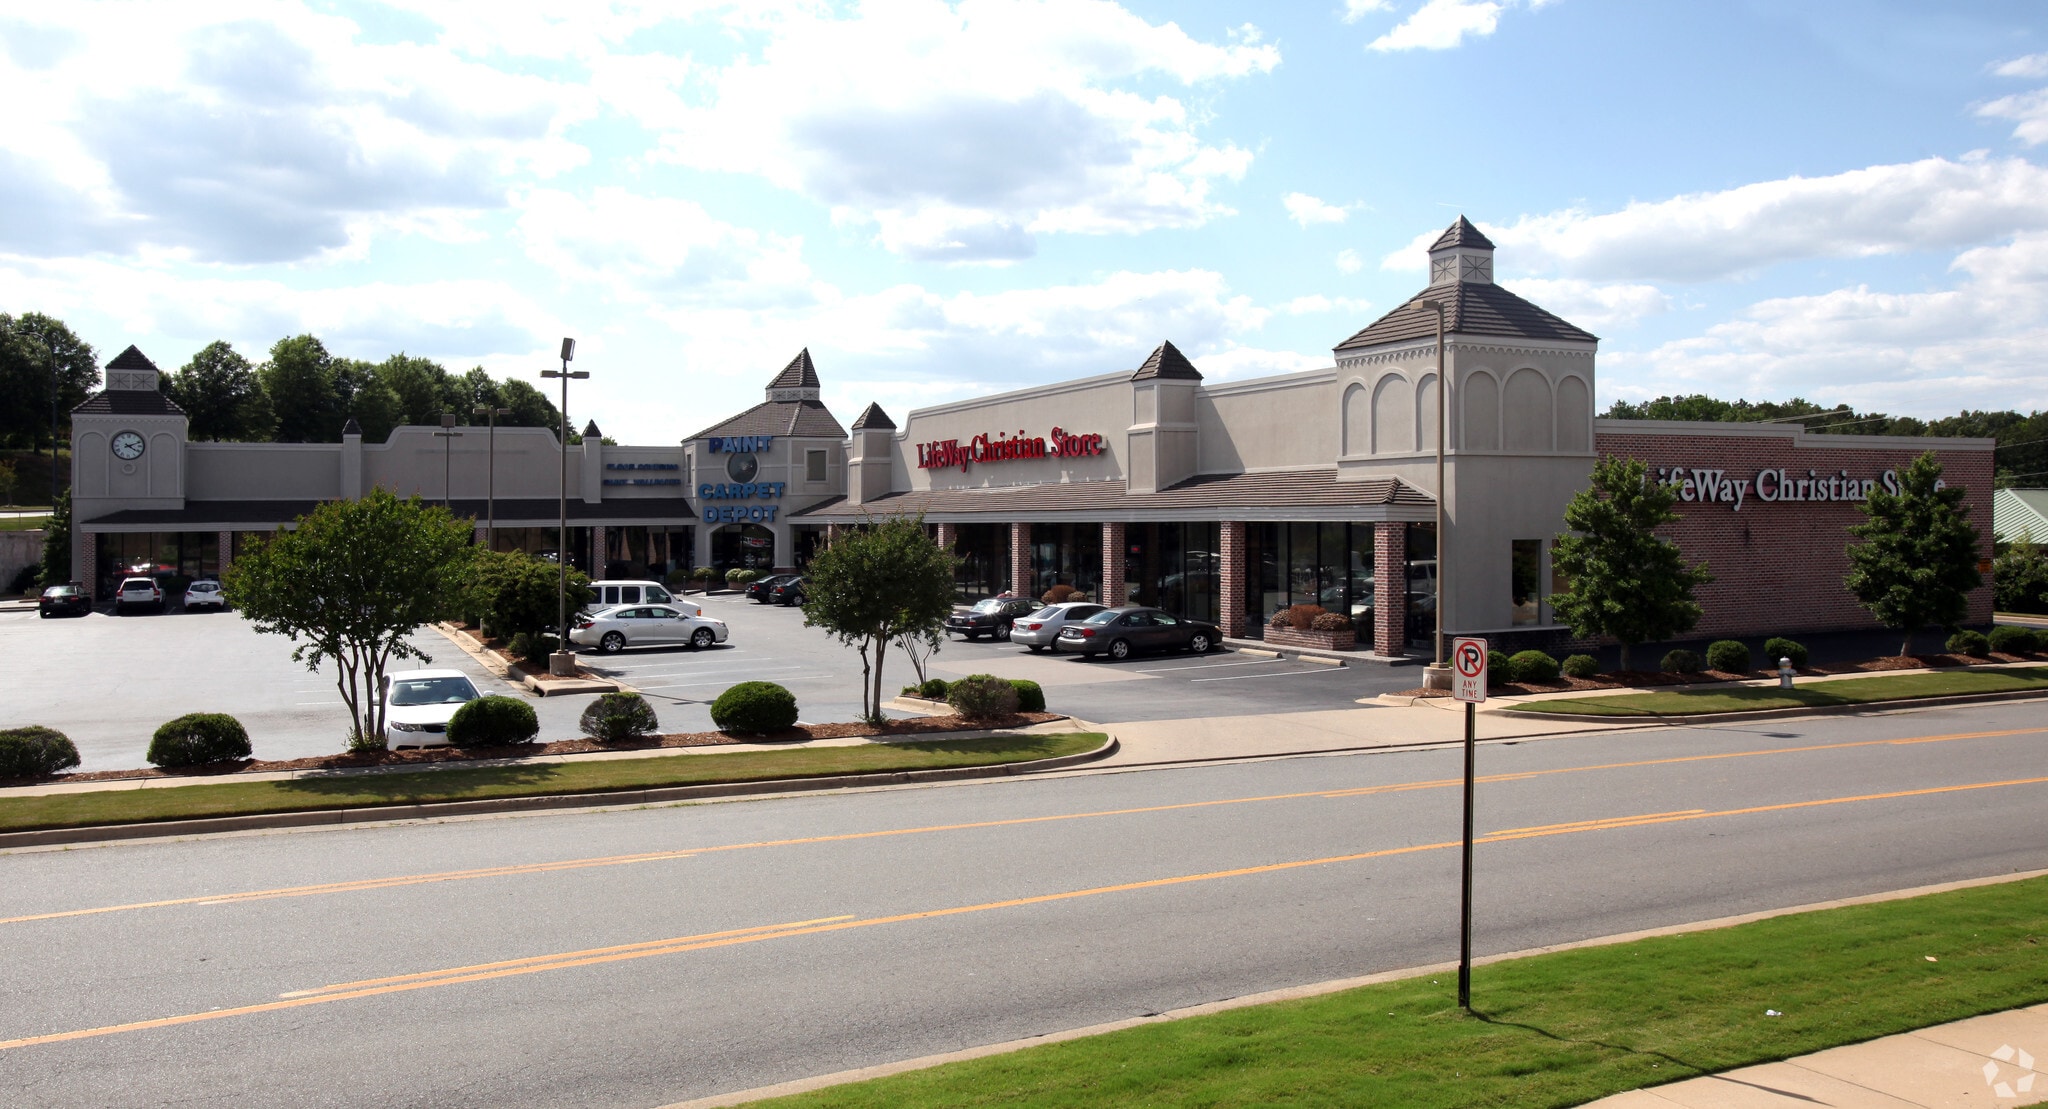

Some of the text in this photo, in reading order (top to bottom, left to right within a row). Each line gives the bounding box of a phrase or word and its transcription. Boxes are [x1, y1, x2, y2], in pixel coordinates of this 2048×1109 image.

[708, 436, 773, 453] PAINT
[916, 426, 1102, 473] LifeWay Christian Store
[698, 482, 785, 499] CARPET
[1756, 467, 1877, 502] Christian
[703, 505, 778, 523] DEPOT
[1462, 680, 1477, 688] ANY
[1461, 689, 1477, 698] TIME
